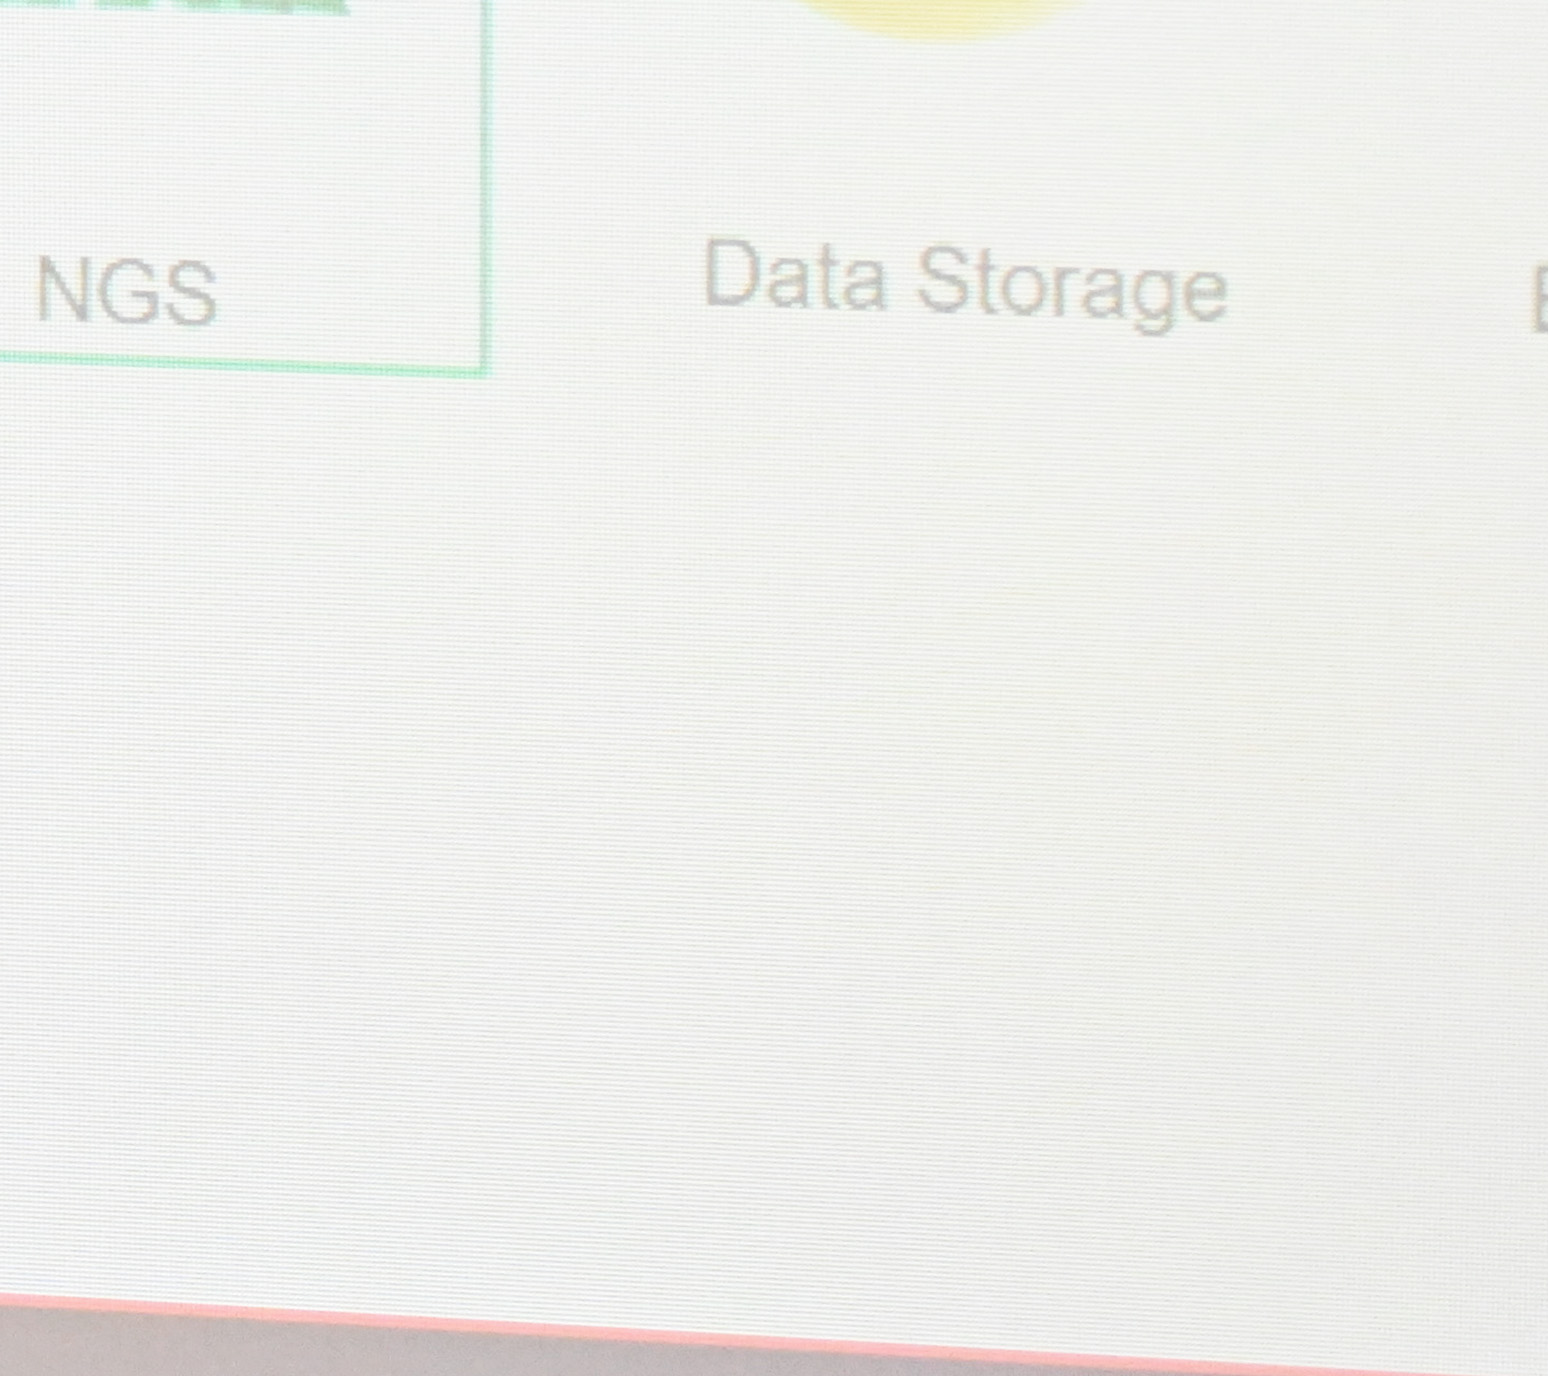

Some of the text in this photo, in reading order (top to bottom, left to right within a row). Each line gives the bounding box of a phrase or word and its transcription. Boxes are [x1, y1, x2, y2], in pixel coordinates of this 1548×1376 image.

[37, 254, 217, 327] NGS
[704, 236, 1228, 338] Data Storage
